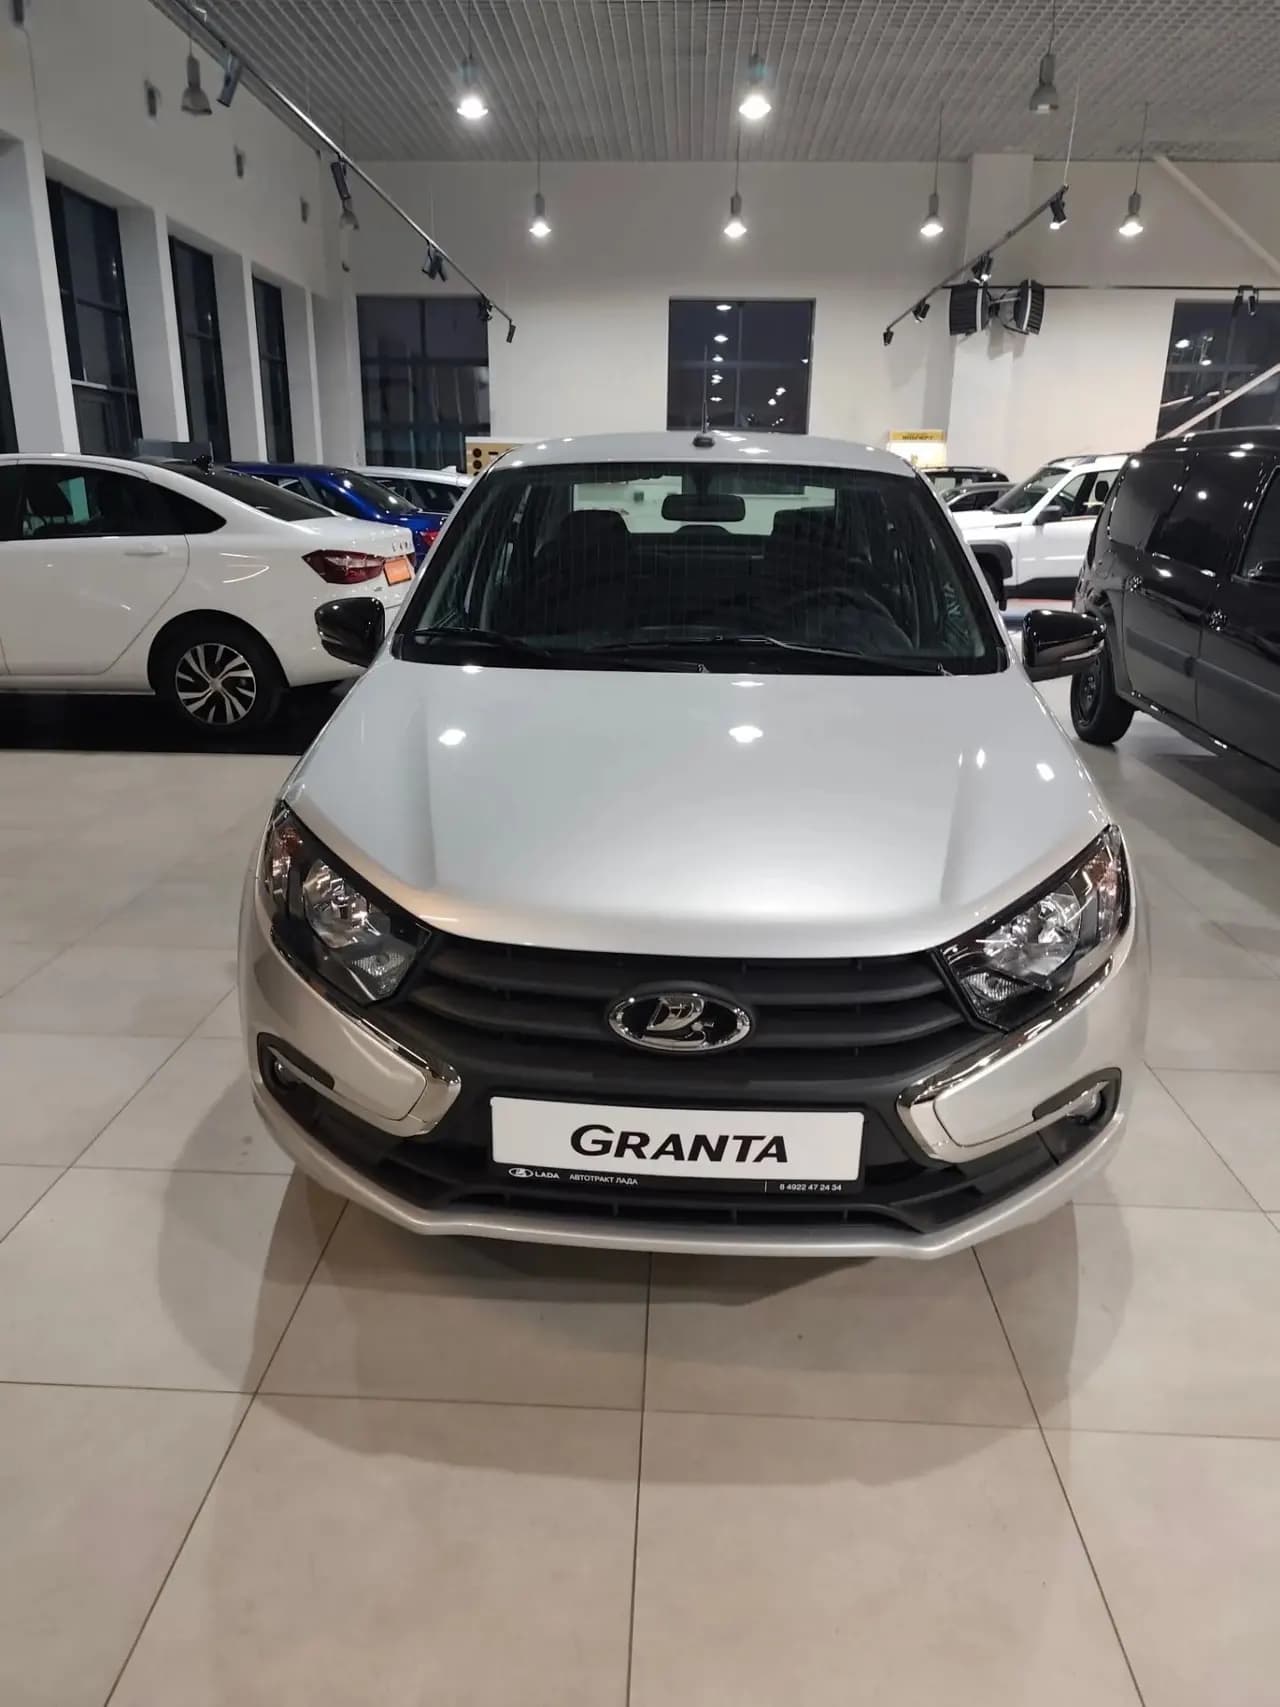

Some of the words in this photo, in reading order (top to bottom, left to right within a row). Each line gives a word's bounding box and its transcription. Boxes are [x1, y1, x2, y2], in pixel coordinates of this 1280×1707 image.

[570, 1124, 788, 1163] GRANTA
[534, 1171, 560, 1180] LADA
[569, 1173, 614, 1184] АВТОТРАКТ
[615, 1176, 639, 1186] ЛАДА
[808, 1183, 819, 1191] 47
